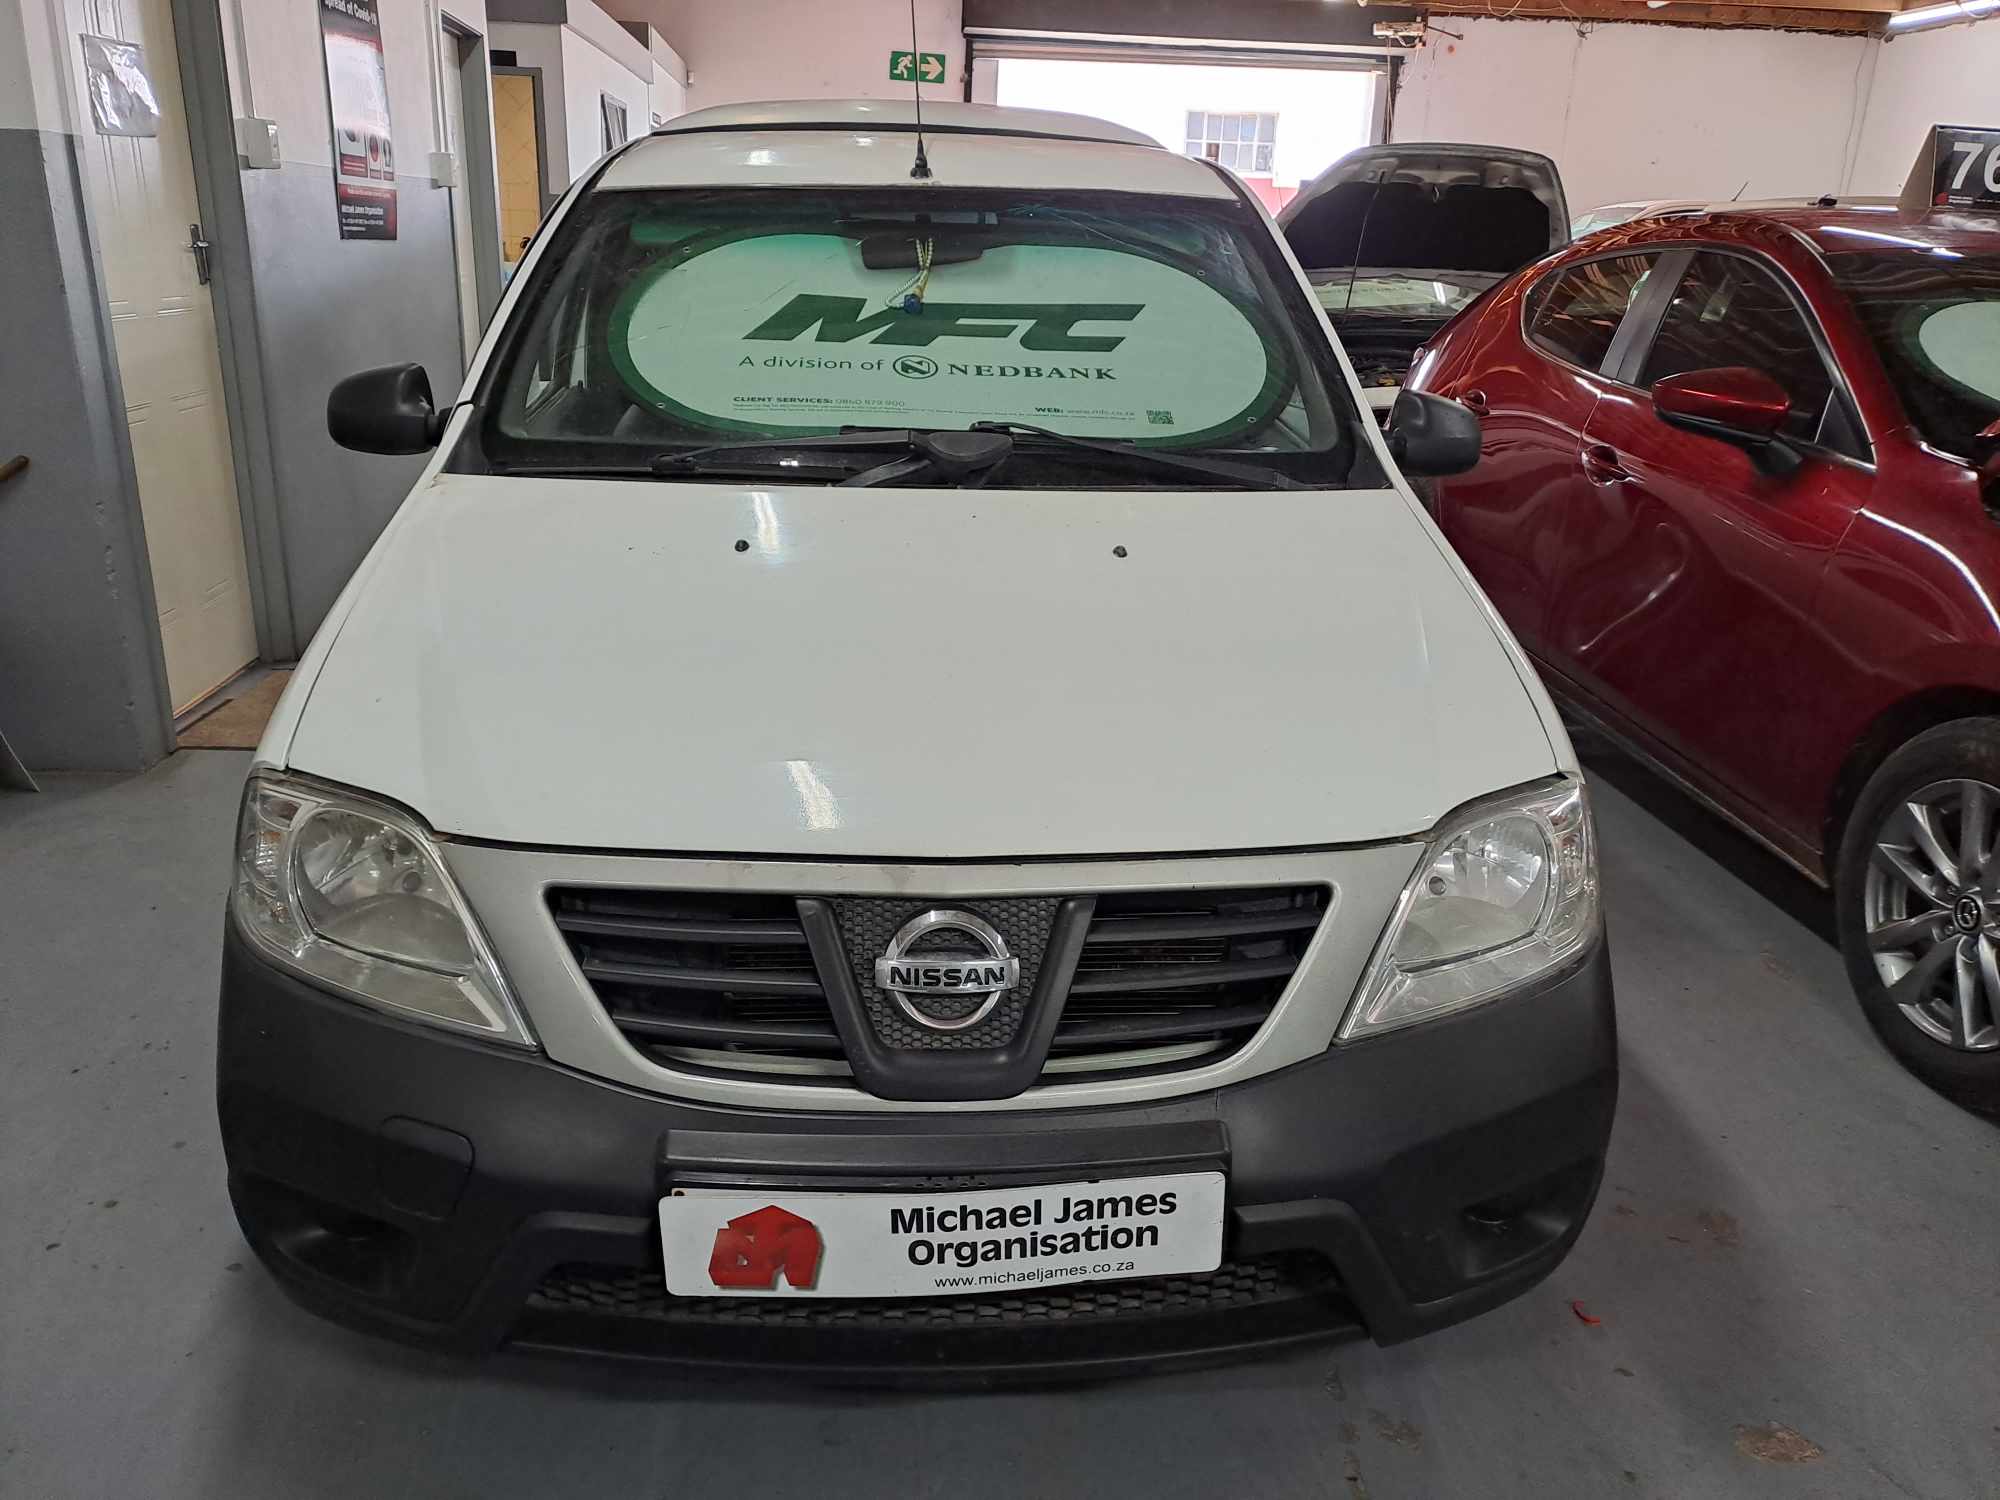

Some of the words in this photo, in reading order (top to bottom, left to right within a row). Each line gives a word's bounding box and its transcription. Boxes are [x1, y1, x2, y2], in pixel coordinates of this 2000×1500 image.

[741, 293, 1146, 352] MFC
[738, 355, 755, 367] A
[763, 356, 853, 370] division
[861, 359, 884, 372] of
[947, 363, 1118, 380] NEDBANK
[776, 396, 833, 405] SERVICES:
[890, 966, 1005, 987] NISSAN
[891, 1197, 1042, 1235] Michael
[1053, 1190, 1177, 1224] James
[908, 1223, 1159, 1268] Organisation
[934, 1260, 1135, 1289] www.michaeljames.co.za
